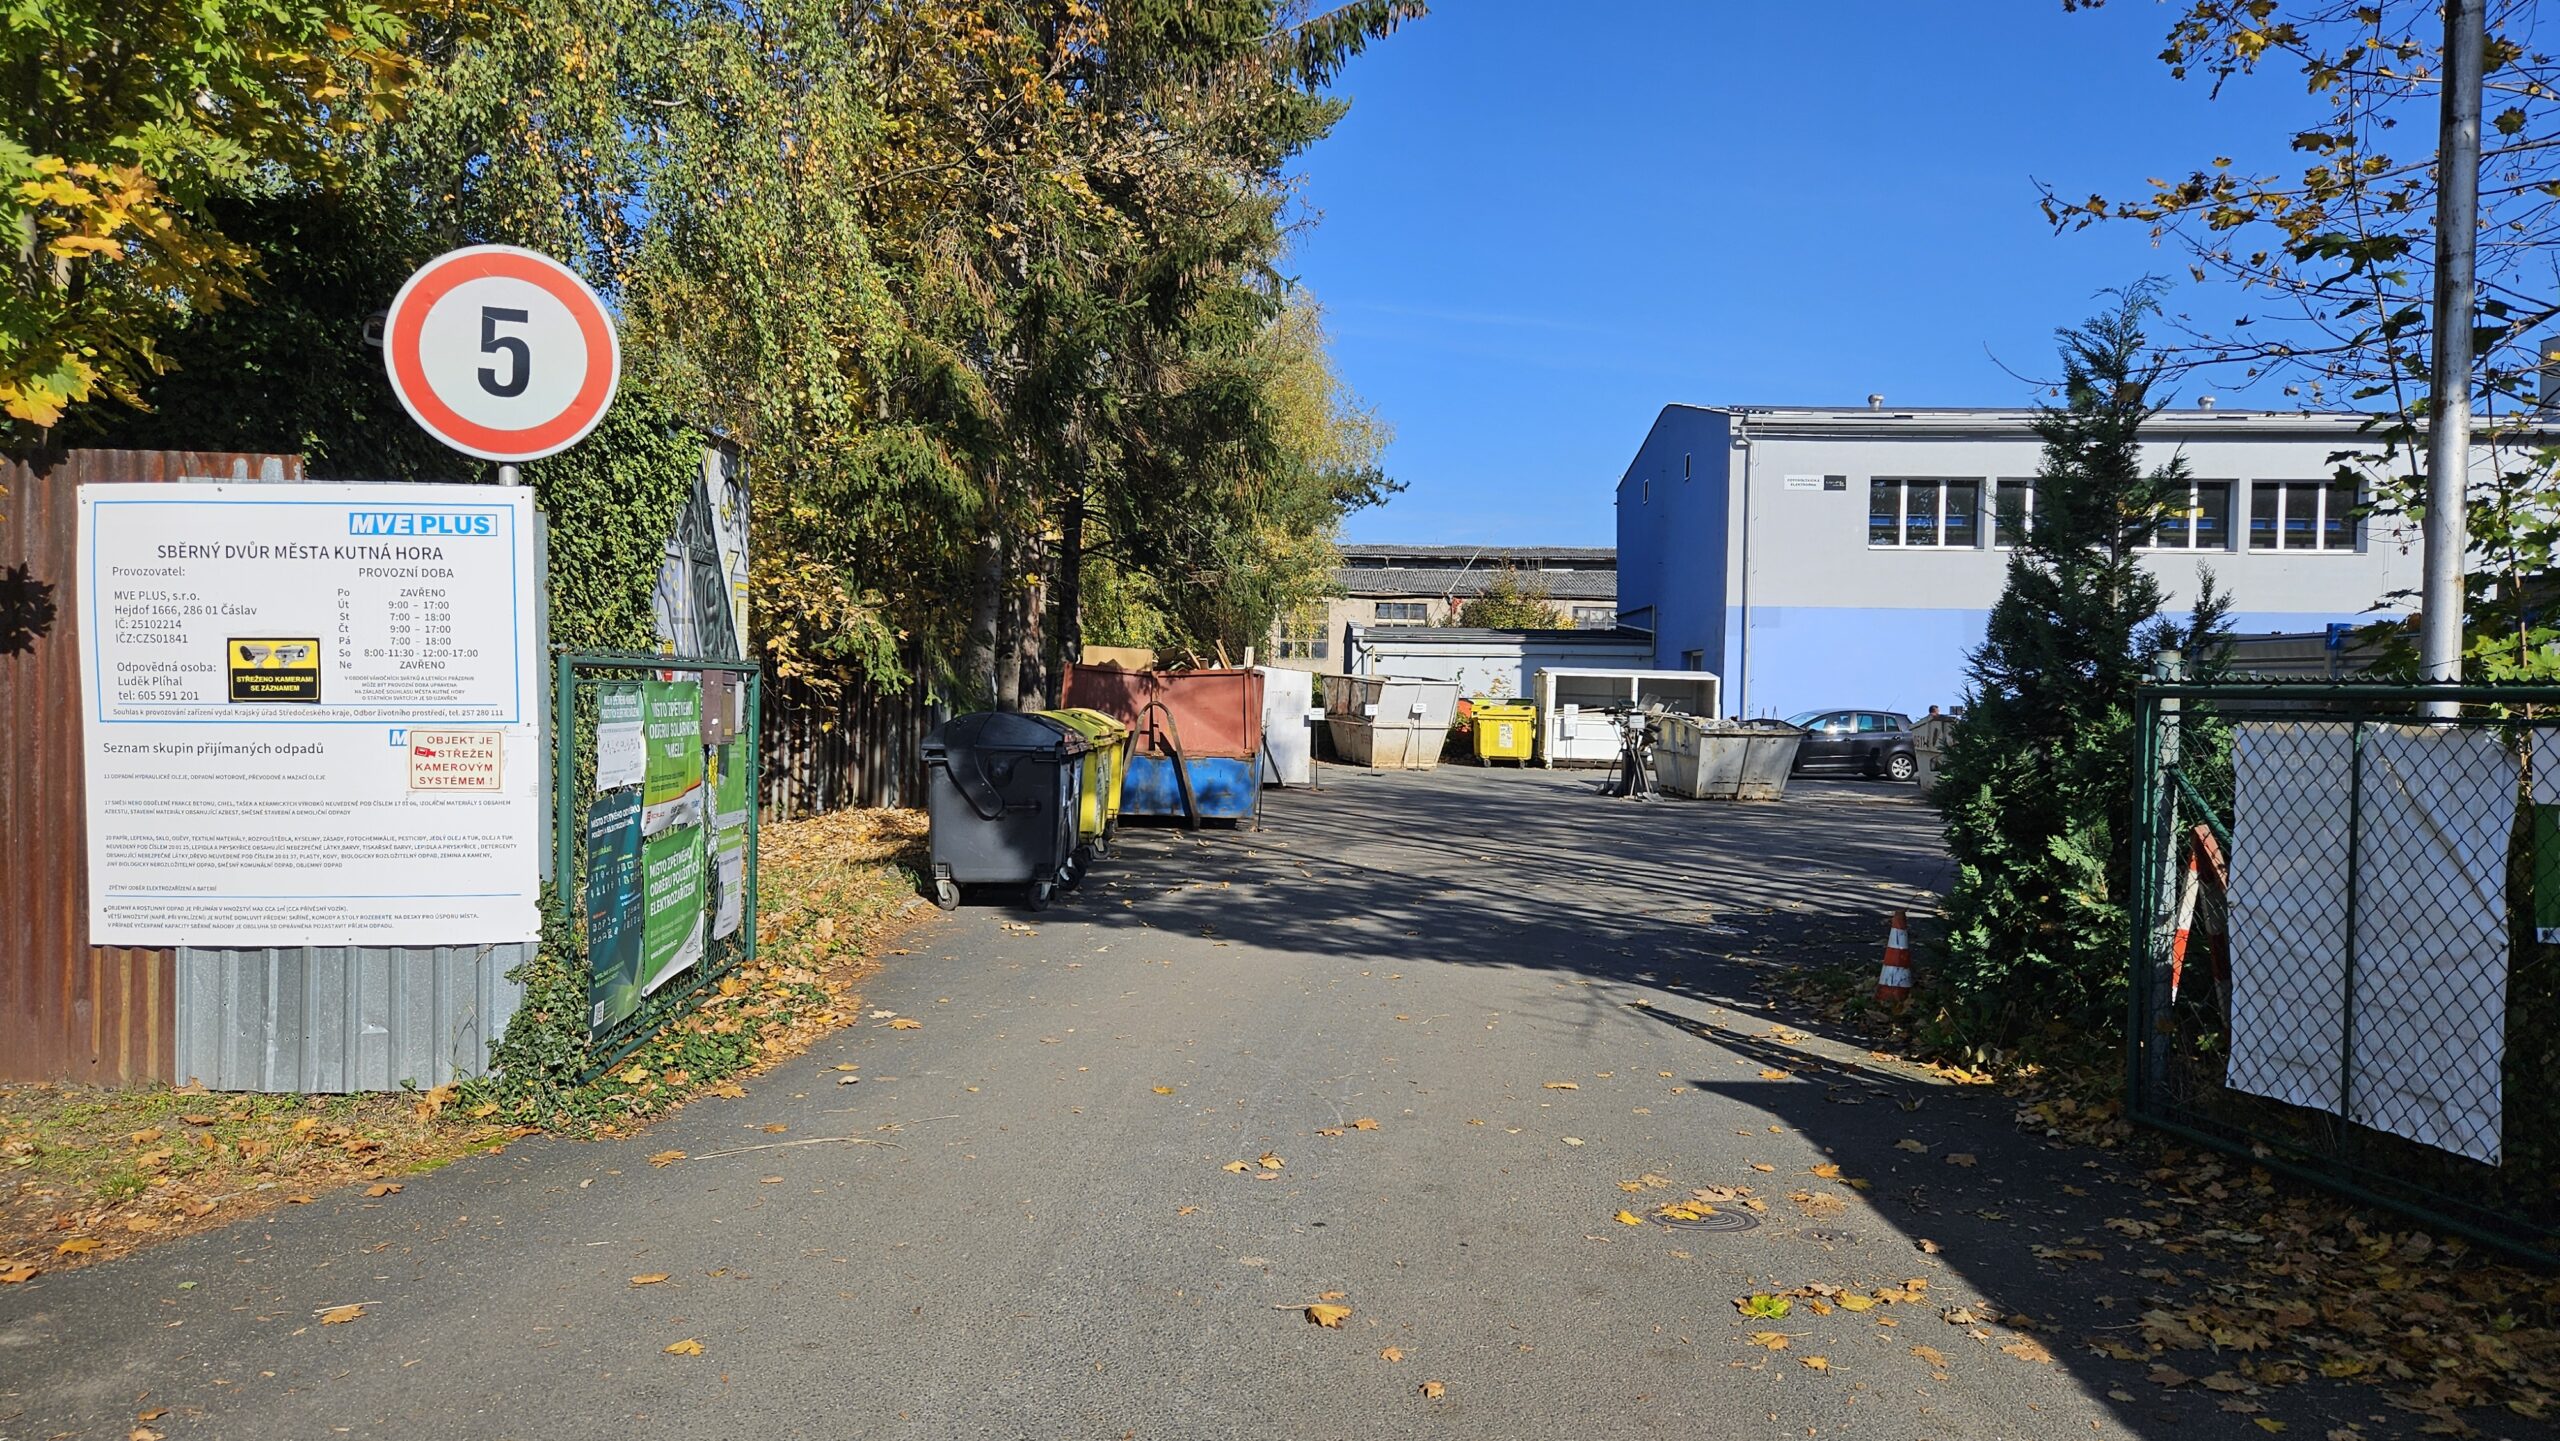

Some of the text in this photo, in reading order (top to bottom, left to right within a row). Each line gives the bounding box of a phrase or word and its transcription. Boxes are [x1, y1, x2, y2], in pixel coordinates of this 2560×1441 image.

[478, 306, 530, 398] 5
[351, 514, 490, 535] MVE PLUS
[157, 540, 443, 560] SBĚRNÝ DVŮR MĚSTA KUTNÁ HORA
[112, 565, 185, 576] Provozovatel:
[358, 565, 454, 578] PROVOZNÍ DOBA
[113, 590, 199, 602] MVE PLUS, s.r.o.
[337, 588, 350, 596] Po
[400, 587, 446, 597] ZAVŘENO
[337, 599, 349, 608] Út
[388, 600, 449, 609] 9:00 17:00
[114, 604, 257, 618] Hejdof 1666, 286 01 Čáslav
[339, 612, 349, 621] St
[391, 612, 450, 621] 7:00 18:00
[115, 618, 182, 629] IČ: 25102214
[338, 623, 349, 632] Čt
[389, 624, 451, 633] 9:00 17:00
[115, 633, 188, 644] IČZ:CZS01841
[338, 635, 350, 644] Pá
[391, 637, 451, 645] 7:00 18:00
[338, 648, 351, 657] So
[364, 648, 478, 657] 8:00-11:30 12:00-17:00
[117, 661, 216, 675] Odpovědná osoba:
[339, 660, 352, 669] Ne
[399, 659, 445, 669] ZAVŘENO
[117, 675, 182, 686] Luděk Plíhal
[236, 674, 274, 683] STŘEŽENO
[261, 684, 300, 692] ZÁZNAMEM
[118, 689, 199, 700] tel: 605 591 201
[145, 708, 186, 716] provozování
[214, 708, 233, 717] vydal
[234, 709, 260, 717] Krajský
[331, 709, 352, 717] kraje,
[377, 709, 410, 718] životního
[411, 709, 447, 717] prostředí,
[427, 736, 493, 745] OBJEKT JE
[103, 741, 324, 758] Seznam skupin přijímaných odpadů
[438, 748, 493, 758] STŘEŽEN
[415, 762, 493, 772] KAMEROVÝM
[419, 776, 485, 785] SYSTÉMEM
[649, 860, 667, 879] MÍSTO
[650, 875, 672, 897] ODBĚRU
